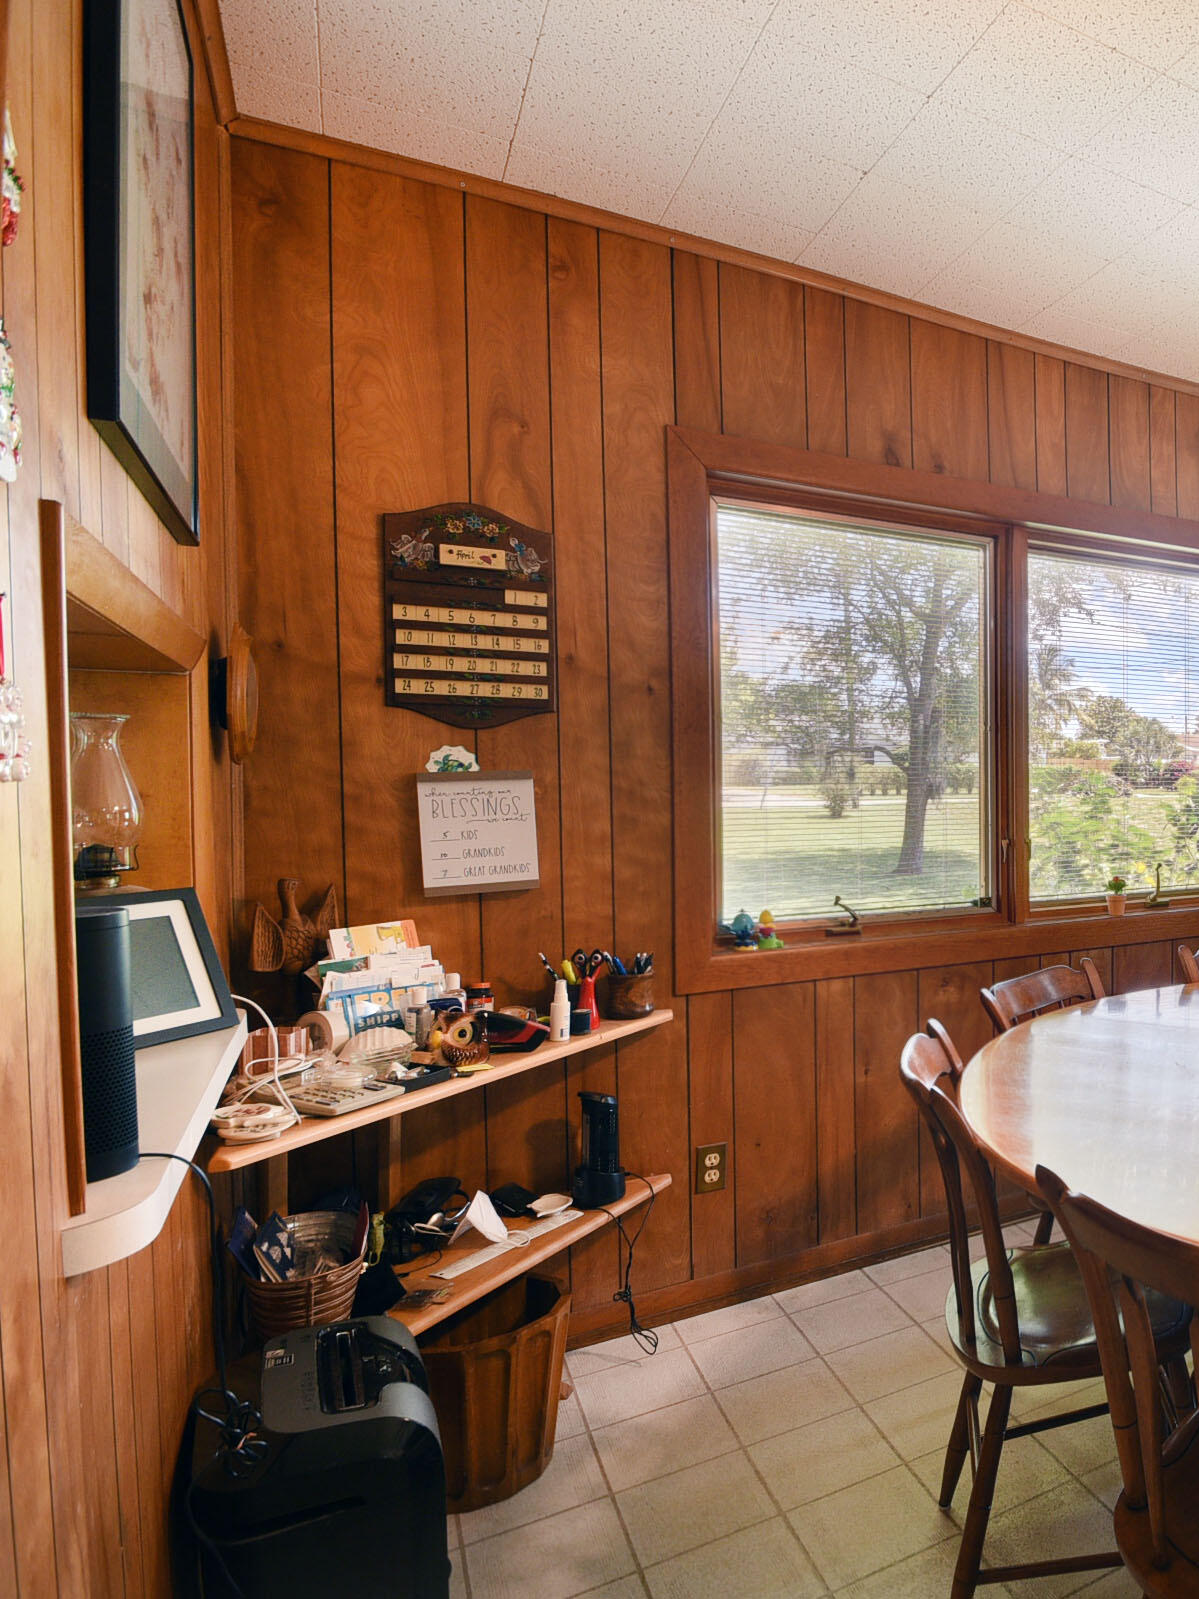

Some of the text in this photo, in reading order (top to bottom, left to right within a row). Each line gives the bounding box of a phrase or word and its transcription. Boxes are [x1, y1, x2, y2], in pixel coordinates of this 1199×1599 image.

[456, 550, 475, 560] April
[514, 592, 539, 605] 1 2
[402, 606, 539, 627] 3 4 5 6 7 8 9
[403, 632, 541, 650] 10 11 12 13 14 15 16
[401, 657, 541, 674] 17 18 19 20 21 22 23
[403, 680, 543, 697] 24 25 26 27 28 29 30
[432, 796, 521, 819] BLESSINGS
[461, 829, 478, 840] KIDS
[462, 847, 505, 859] GRANDKIDS
[464, 863, 531, 878] GREAT GRANDKIDS
